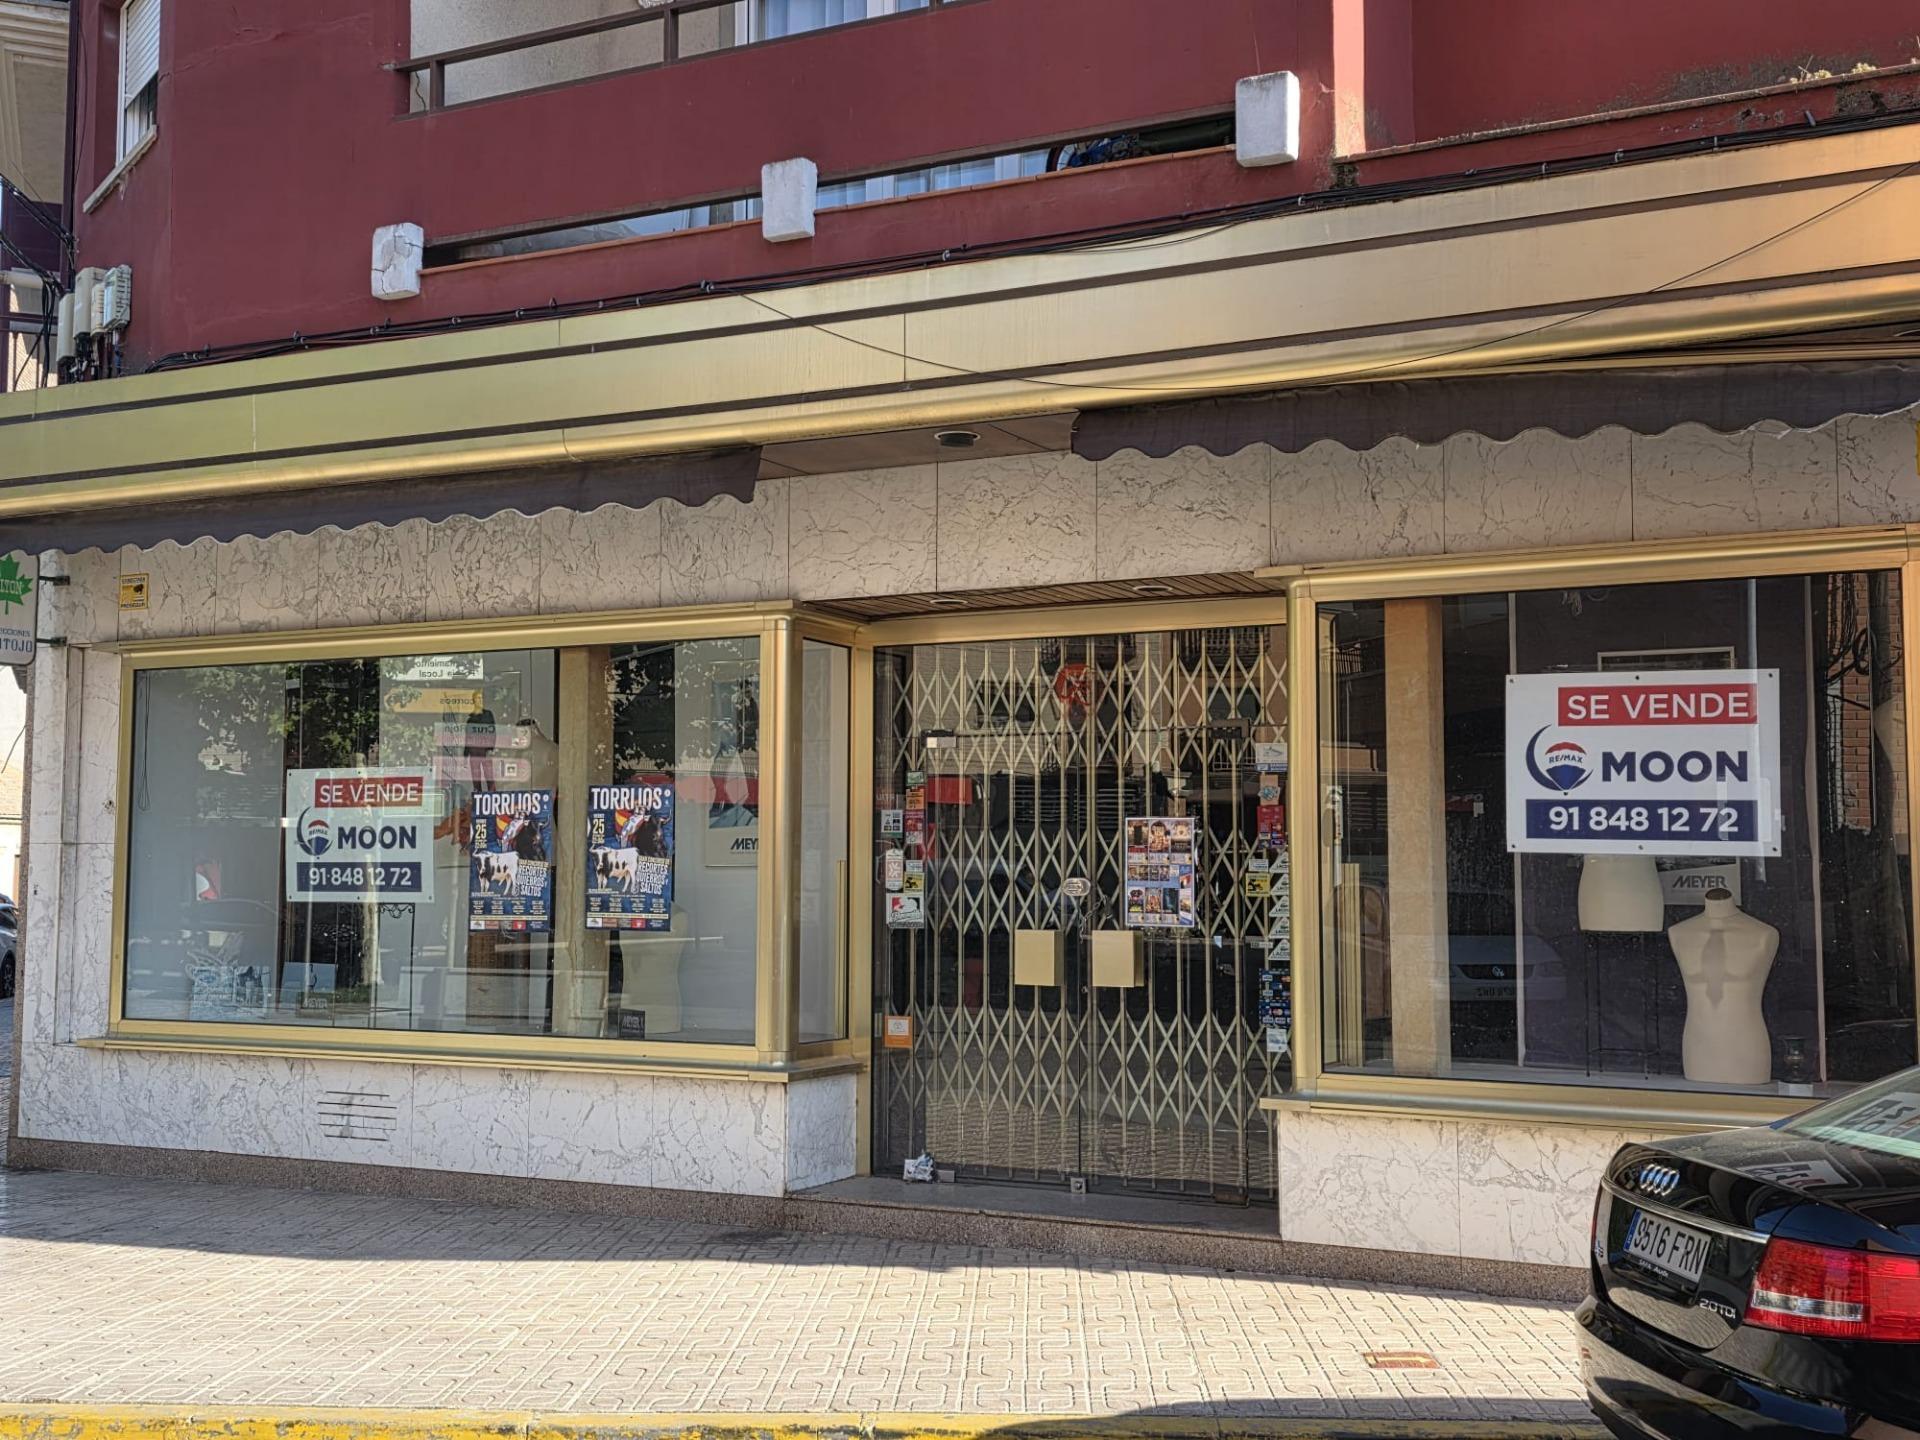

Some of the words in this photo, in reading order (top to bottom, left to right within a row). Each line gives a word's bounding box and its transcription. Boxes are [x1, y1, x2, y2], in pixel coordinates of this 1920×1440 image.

[0, 638, 33, 653] TOJO
[1567, 694, 1610, 720] SE
[1621, 692, 1749, 719] VENDE
[1548, 754, 1583, 764] RE/MAX
[1602, 750, 1748, 782] MOON
[320, 785, 343, 803] SE
[350, 783, 419, 802] VENDE
[591, 787, 663, 810] TORRIJOS
[473, 792, 541, 816] TORRIJOS
[592, 819, 604, 834] 25
[1549, 806, 1580, 831] 91
[1589, 806, 1649, 832] 848
[1657, 807, 1690, 832] 12
[1700, 807, 1738, 833] 72
[337, 826, 417, 849] MOON
[475, 824, 487, 839] 25
[729, 837, 759, 850] MEY
[309, 868, 326, 885] 91
[331, 867, 364, 885] 848
[368, 868, 386, 885] 12
[390, 868, 412, 885] 72
[1672, 875, 1727, 888] MEYER
[520, 885, 541, 897] SALTOS
[639, 882, 662, 895] SALTOS
[1634, 1217, 1671, 1259] 9516
[1667, 1231, 1708, 1274] FRN
